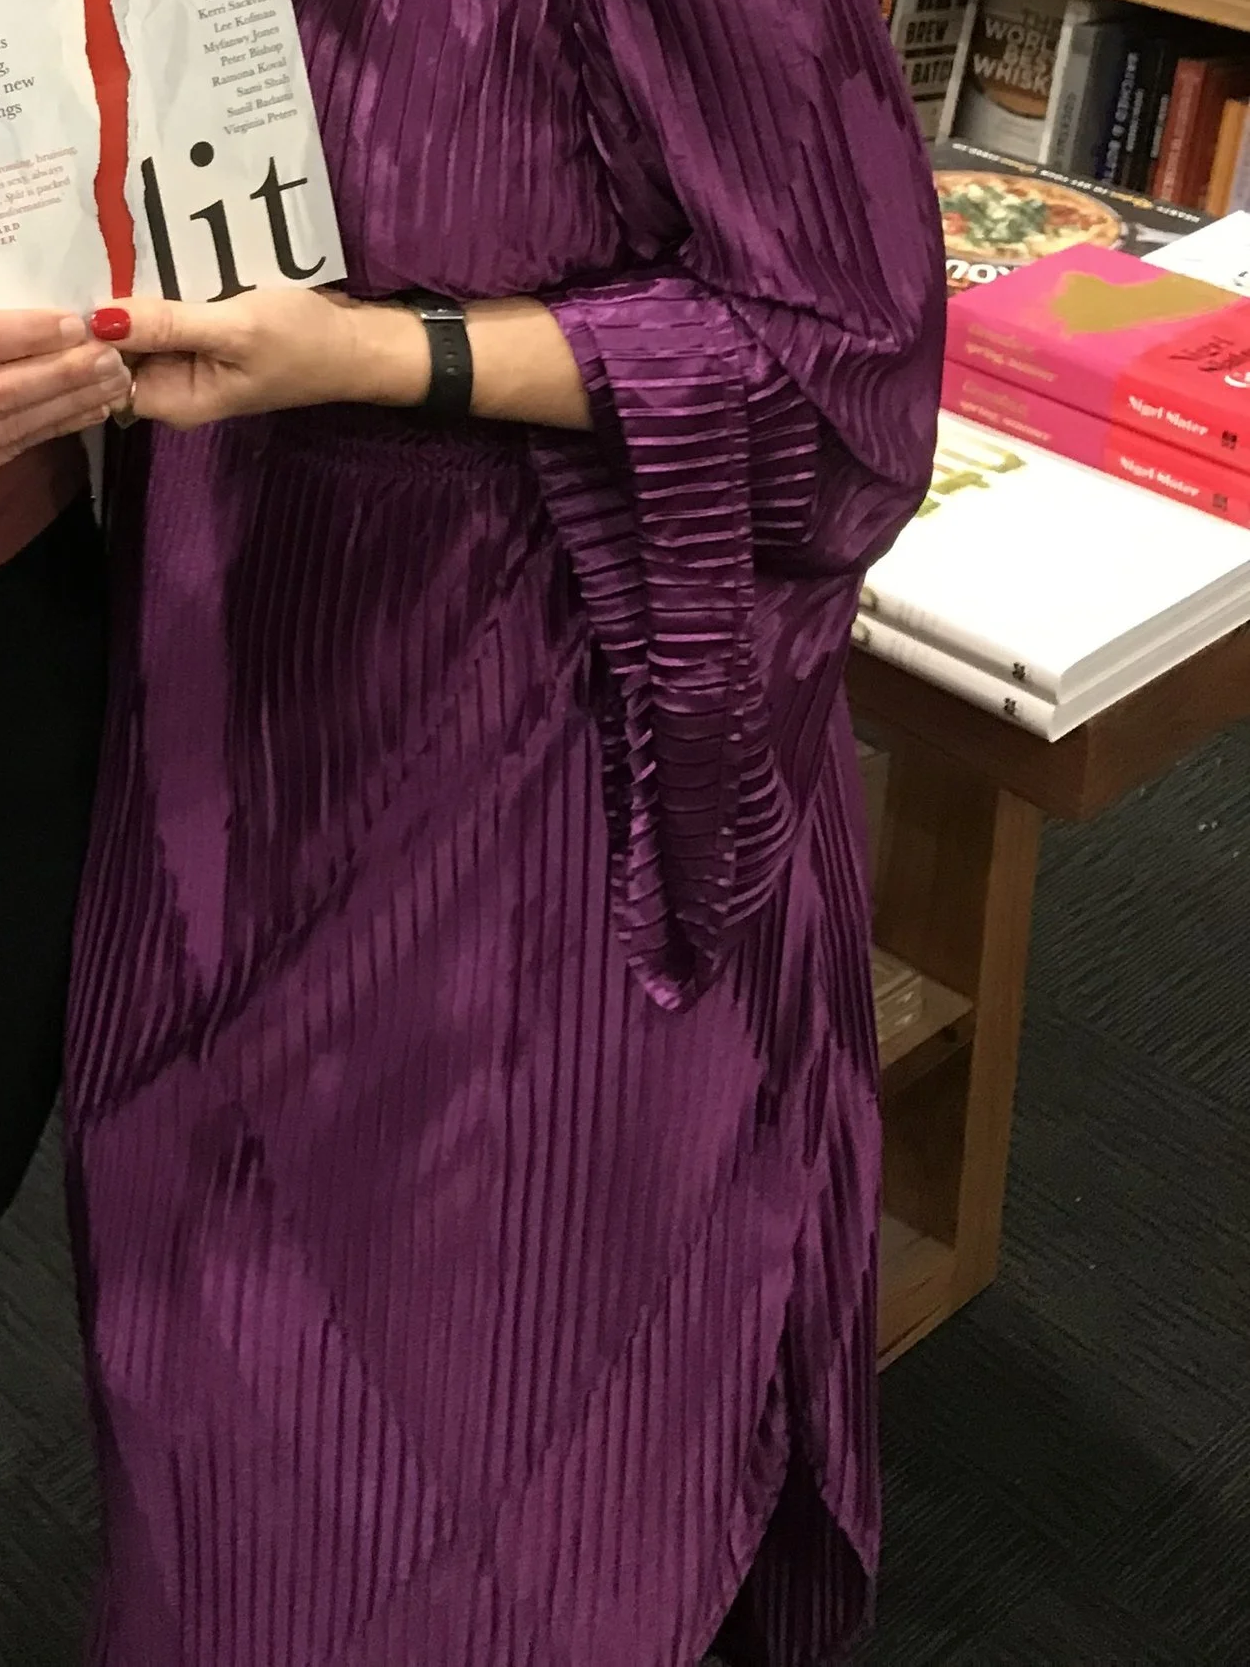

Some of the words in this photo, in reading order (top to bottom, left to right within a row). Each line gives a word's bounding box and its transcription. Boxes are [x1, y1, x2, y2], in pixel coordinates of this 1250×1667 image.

[198, 3, 226, 20] Kerri
[213, 21, 233, 33] Lee
[235, 8, 276, 28] Kofman
[203, 35, 249, 55] Myfanwy
[251, 26, 280, 43] Jones
[220, 52, 246, 67] Peter
[249, 42, 284, 58] Bishop
[211, 68, 255, 87] Ramona
[257, 56, 287, 74] Koval
[4, 77, 35, 94] new
[236, 84, 262, 97] Sami
[264, 74, 290, 89] Shah
[226, 101, 253, 118] Sunil
[256, 92, 294, 110] Badami
[223, 118, 265, 135] Virginia
[267, 107, 298, 124] Peters
[31, 165, 64, 182] always
[37, 177, 71, 196] packed
[141, 141, 326, 302] lit
[1127, 395, 1163, 420] Nigel
[1119, 455, 1155, 480] Nigel
